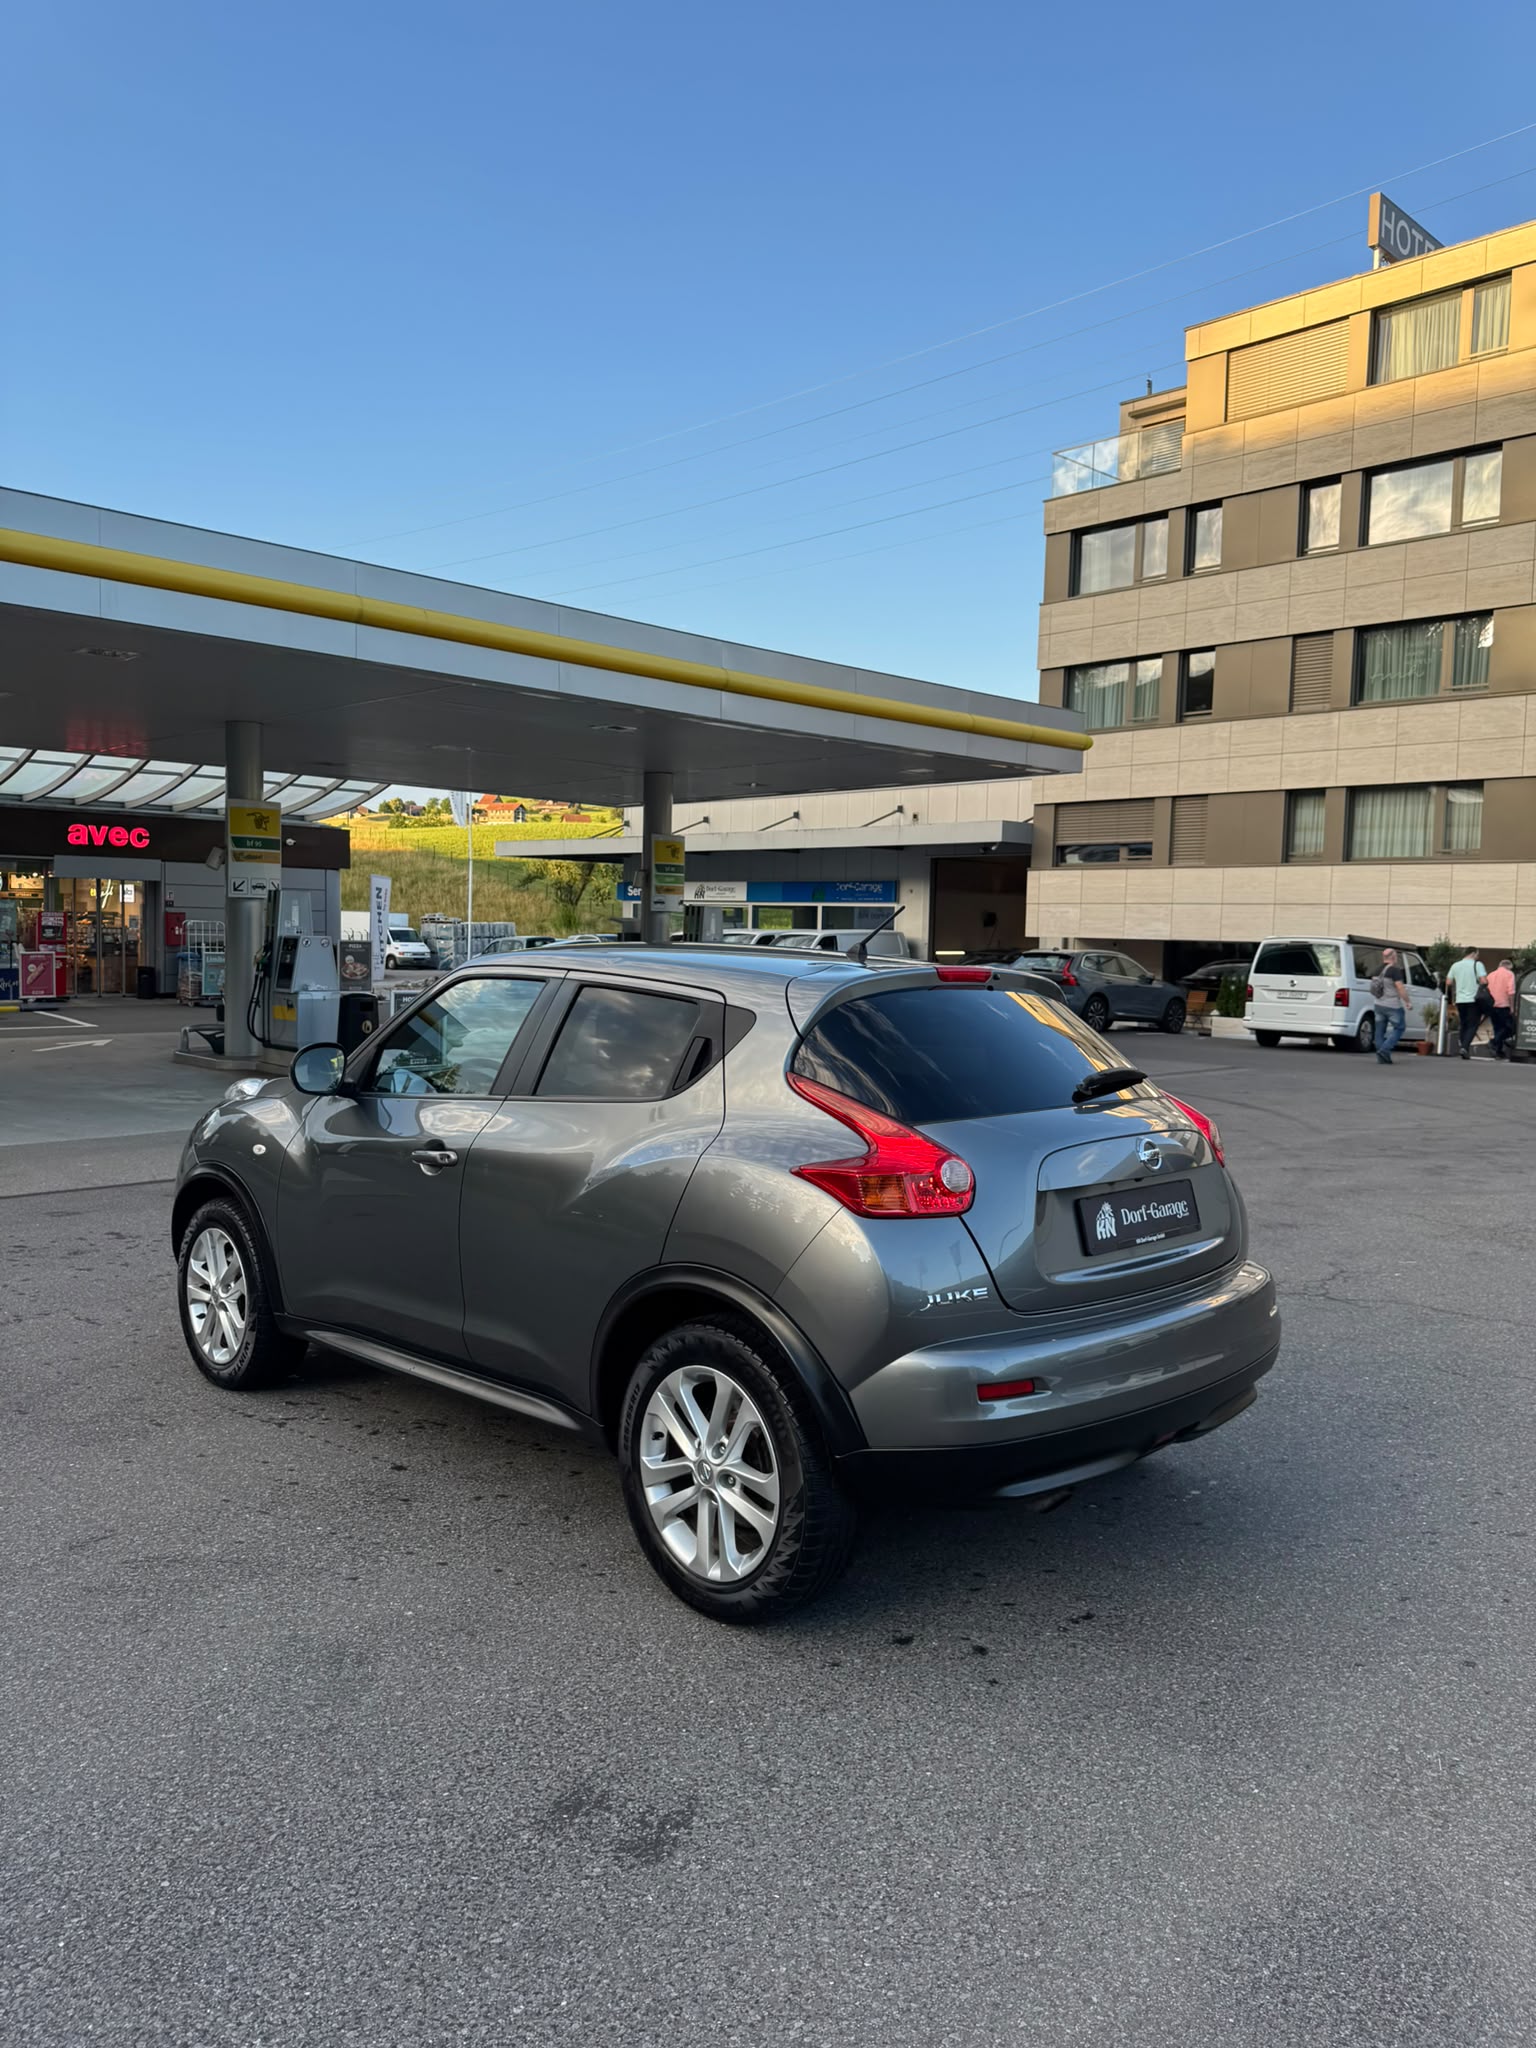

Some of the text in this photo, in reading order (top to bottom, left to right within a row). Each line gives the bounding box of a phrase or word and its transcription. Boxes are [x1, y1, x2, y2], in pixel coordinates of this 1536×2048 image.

[67, 824, 150, 848] avec
[375, 887, 385, 965] KITCHEN
[1120, 1200, 1190, 1226] Dorf-Garage
[919, 1287, 989, 1312] JUKE
